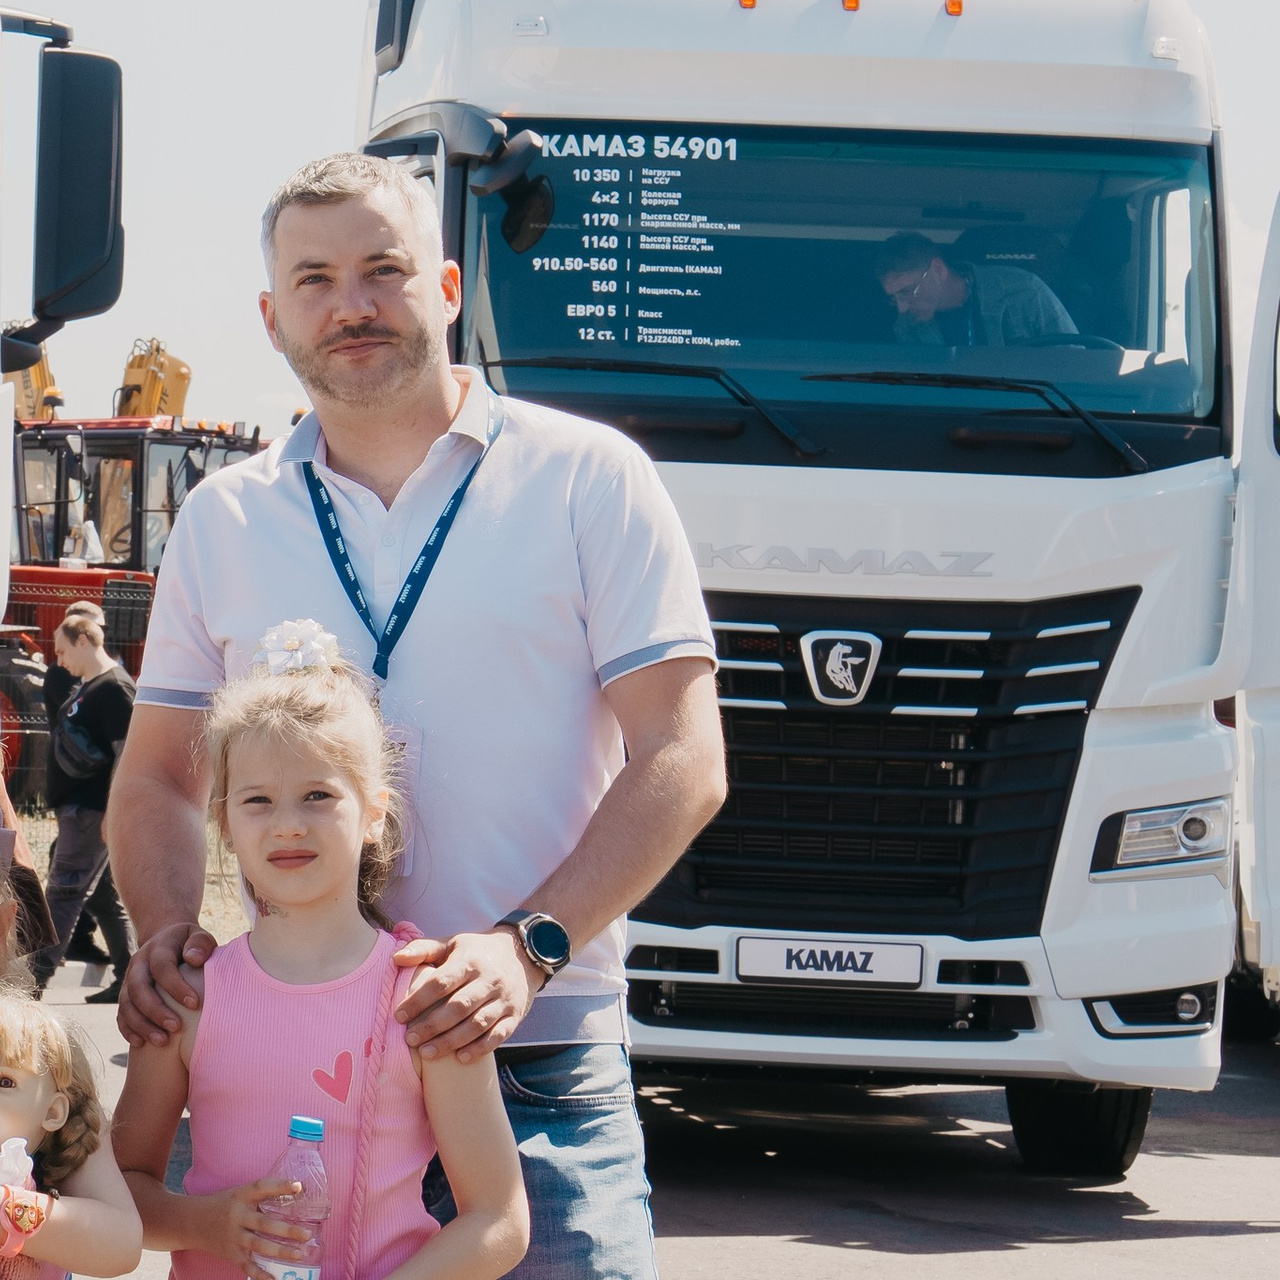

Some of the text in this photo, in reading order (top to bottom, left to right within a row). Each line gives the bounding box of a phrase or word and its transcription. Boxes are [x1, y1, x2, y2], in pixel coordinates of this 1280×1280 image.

[541, 134, 736, 161] КАМАЗ 54901
[573, 169, 620, 182] 10 350
[642, 168, 681, 178] Нагрузка
[653, 176, 670, 184] ССУ
[641, 190, 682, 199] Колесная
[641, 198, 679, 206] формула
[583, 213, 619, 226] 1170
[641, 213, 708, 223] Высота ССУ при
[699, 222, 726, 230] массе,
[582, 235, 618, 248] 1140
[640, 235, 671, 243] Высота
[690, 237, 707, 245] при
[640, 242, 671, 250] полной
[672, 244, 699, 252] массе,
[532, 258, 617, 271] 910.50-560
[639, 264, 722, 274] Двигатель (КАМАЗ)
[592, 281, 617, 292] 560
[638, 286, 684, 296] Мощность,
[567, 305, 616, 317] ЕВРО 5
[638, 310, 662, 318] Класс
[579, 328, 615, 340] 12 ст.
[637, 327, 692, 336] Трансмиссия
[691, 337, 713, 346] КОМ,
[715, 338, 741, 347] робот.
[412, 555, 426, 574] KAMAZ
[697, 542, 994, 577] KAMAZ
[398, 583, 412, 603] KAMAZ
[385, 614, 398, 635] KAMAZ
[785, 947, 875, 974] KAMAZ
